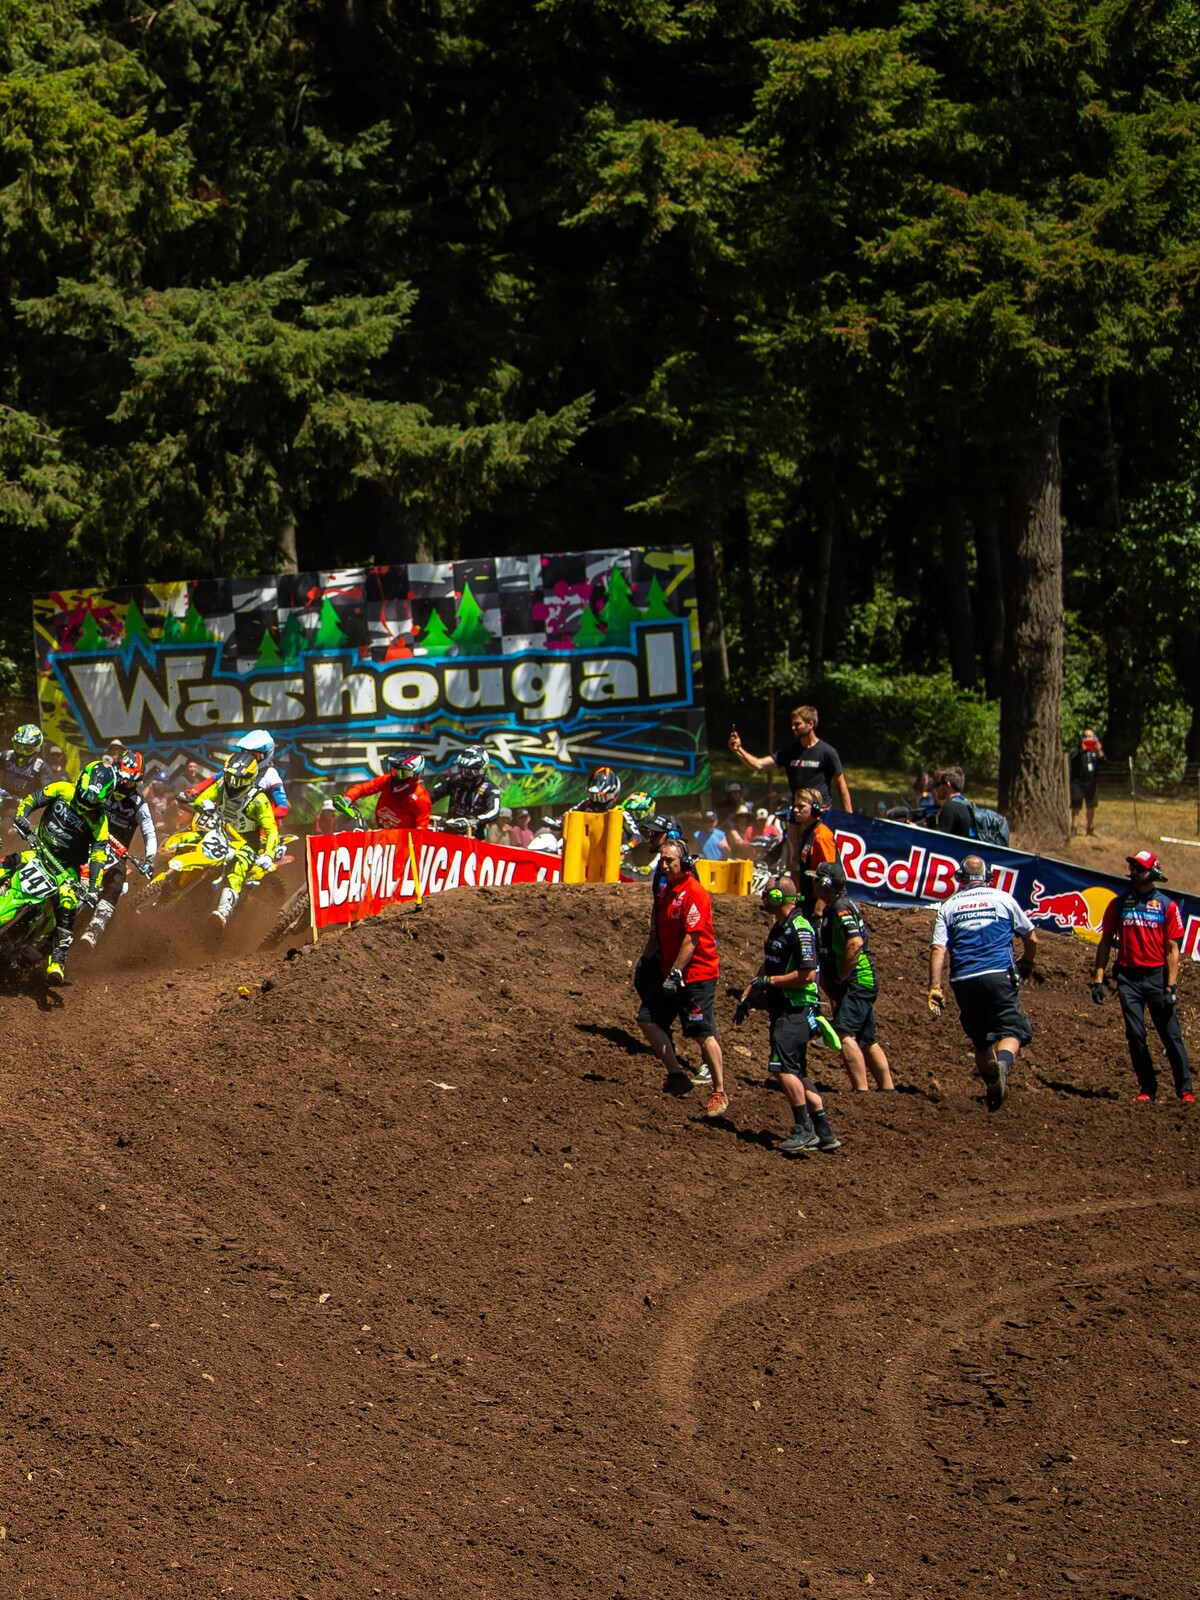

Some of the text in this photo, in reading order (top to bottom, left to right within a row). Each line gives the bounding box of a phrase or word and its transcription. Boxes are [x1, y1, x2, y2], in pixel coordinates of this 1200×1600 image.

[67, 631, 678, 740] Washougal
[19, 866, 54, 900] 447
[835, 830, 925, 896] Red
[920, 852, 1019, 900] Bll
[957, 903, 977, 911] LUCAS
